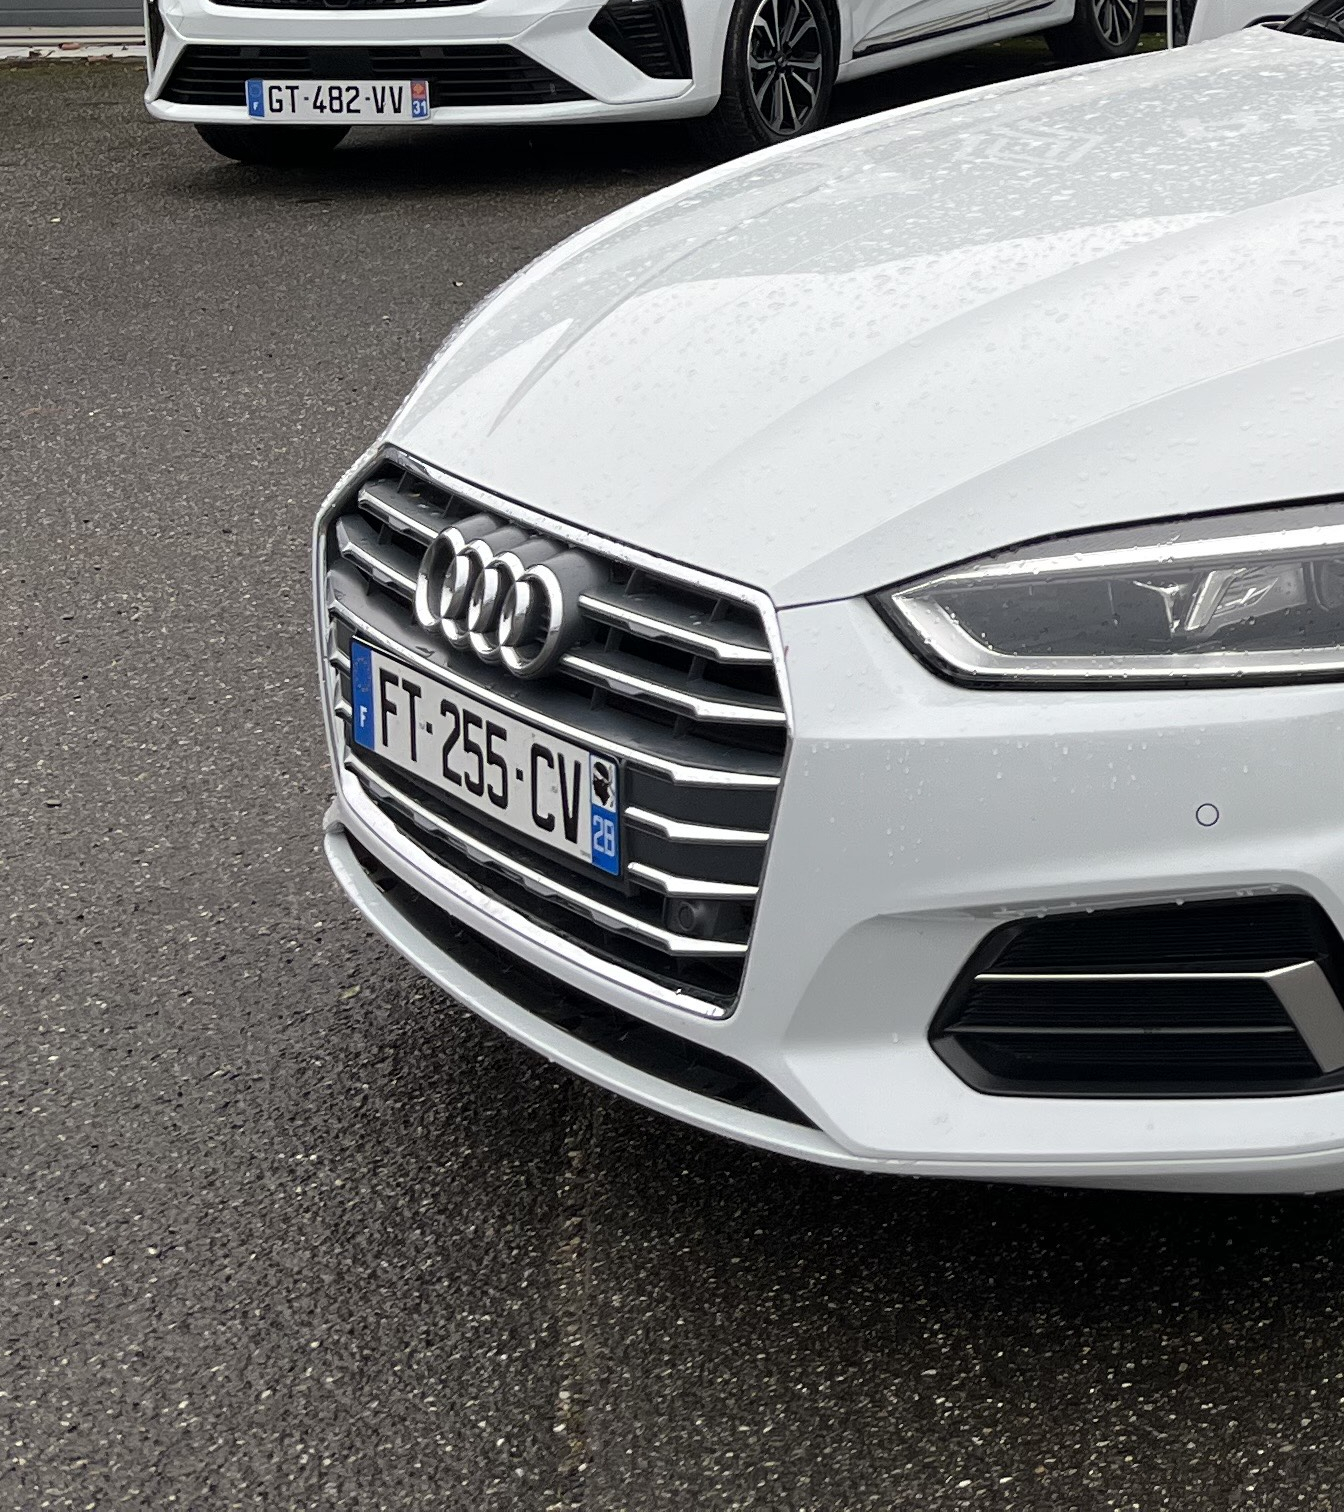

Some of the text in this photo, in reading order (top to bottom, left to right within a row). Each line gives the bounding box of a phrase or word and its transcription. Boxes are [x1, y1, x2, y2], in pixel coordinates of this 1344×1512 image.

[268, 85, 403, 113] GT-482-VV
[413, 100, 427, 115] 31
[359, 705, 368, 728] F
[379, 667, 581, 844] FT-255-CV
